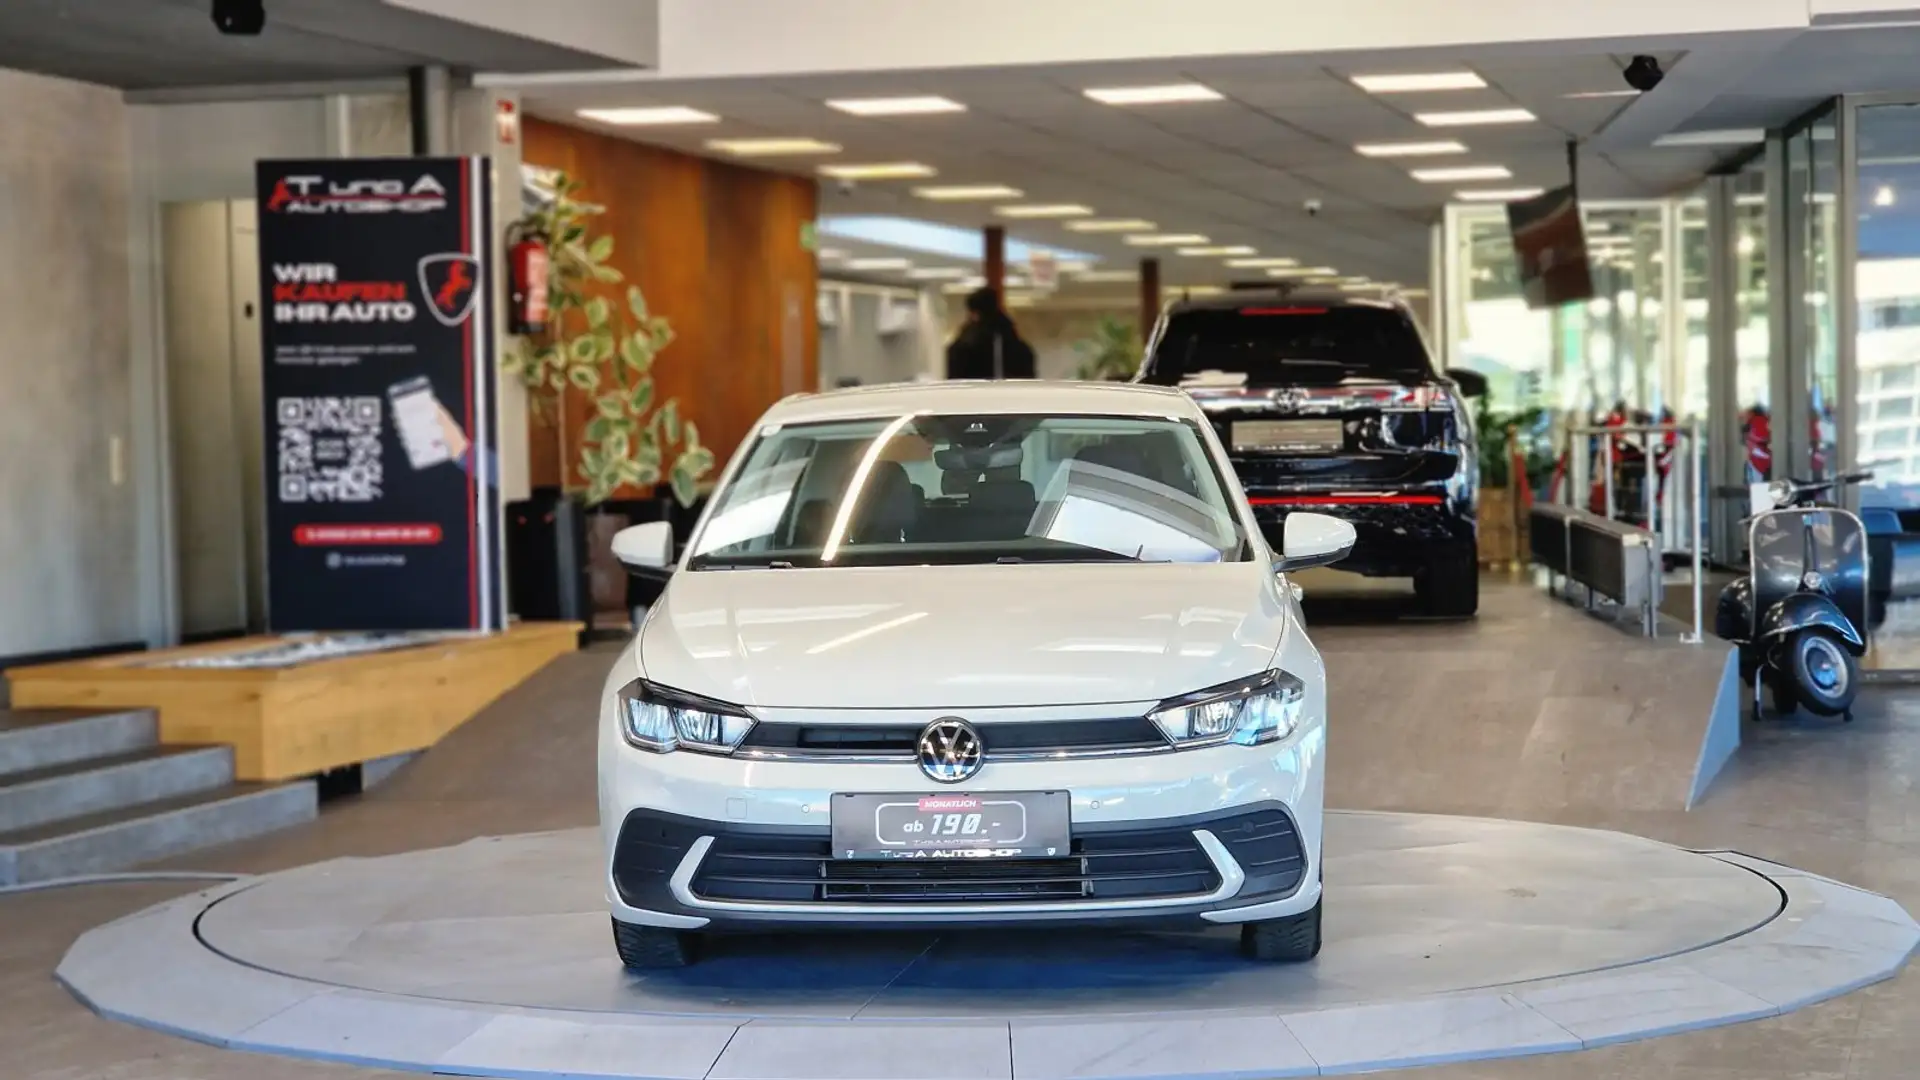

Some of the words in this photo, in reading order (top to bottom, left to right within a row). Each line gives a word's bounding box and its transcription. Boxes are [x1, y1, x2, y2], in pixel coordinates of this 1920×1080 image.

[408, 173, 446, 196] A
[272, 262, 337, 283] WIR
[272, 282, 407, 302] KAUFEN
[273, 302, 330, 322] IHR
[331, 301, 417, 322] AUTO
[924, 800, 977, 809] MONATLICH
[903, 820, 924, 832] ab
[932, 848, 1023, 858] AUTOSHOP
